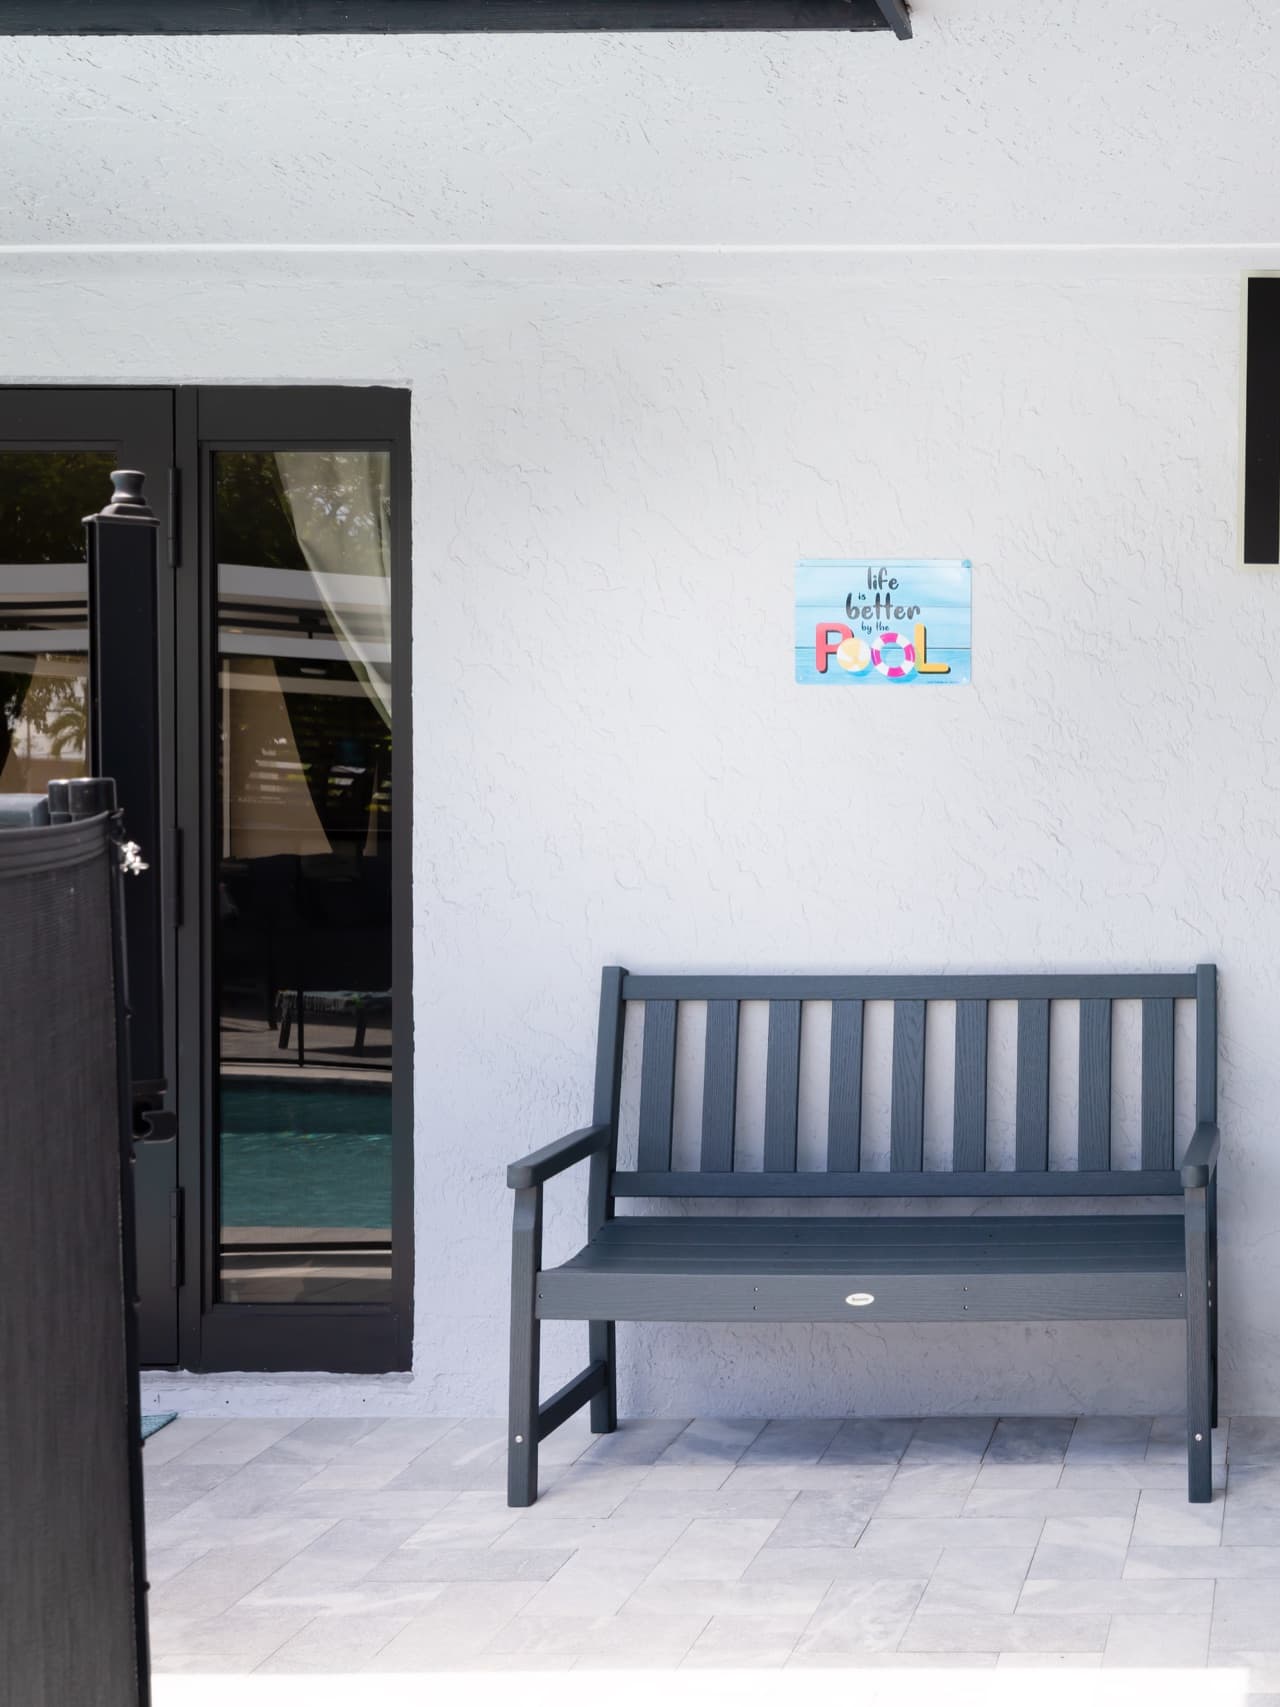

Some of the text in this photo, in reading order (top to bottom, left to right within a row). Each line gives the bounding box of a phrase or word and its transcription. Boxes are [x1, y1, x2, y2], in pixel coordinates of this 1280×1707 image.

[867, 566, 899, 590] life
[845, 592, 921, 620] better
[858, 592, 866, 601] is
[861, 621, 889, 635] by the
[815, 622, 951, 678] POOL
